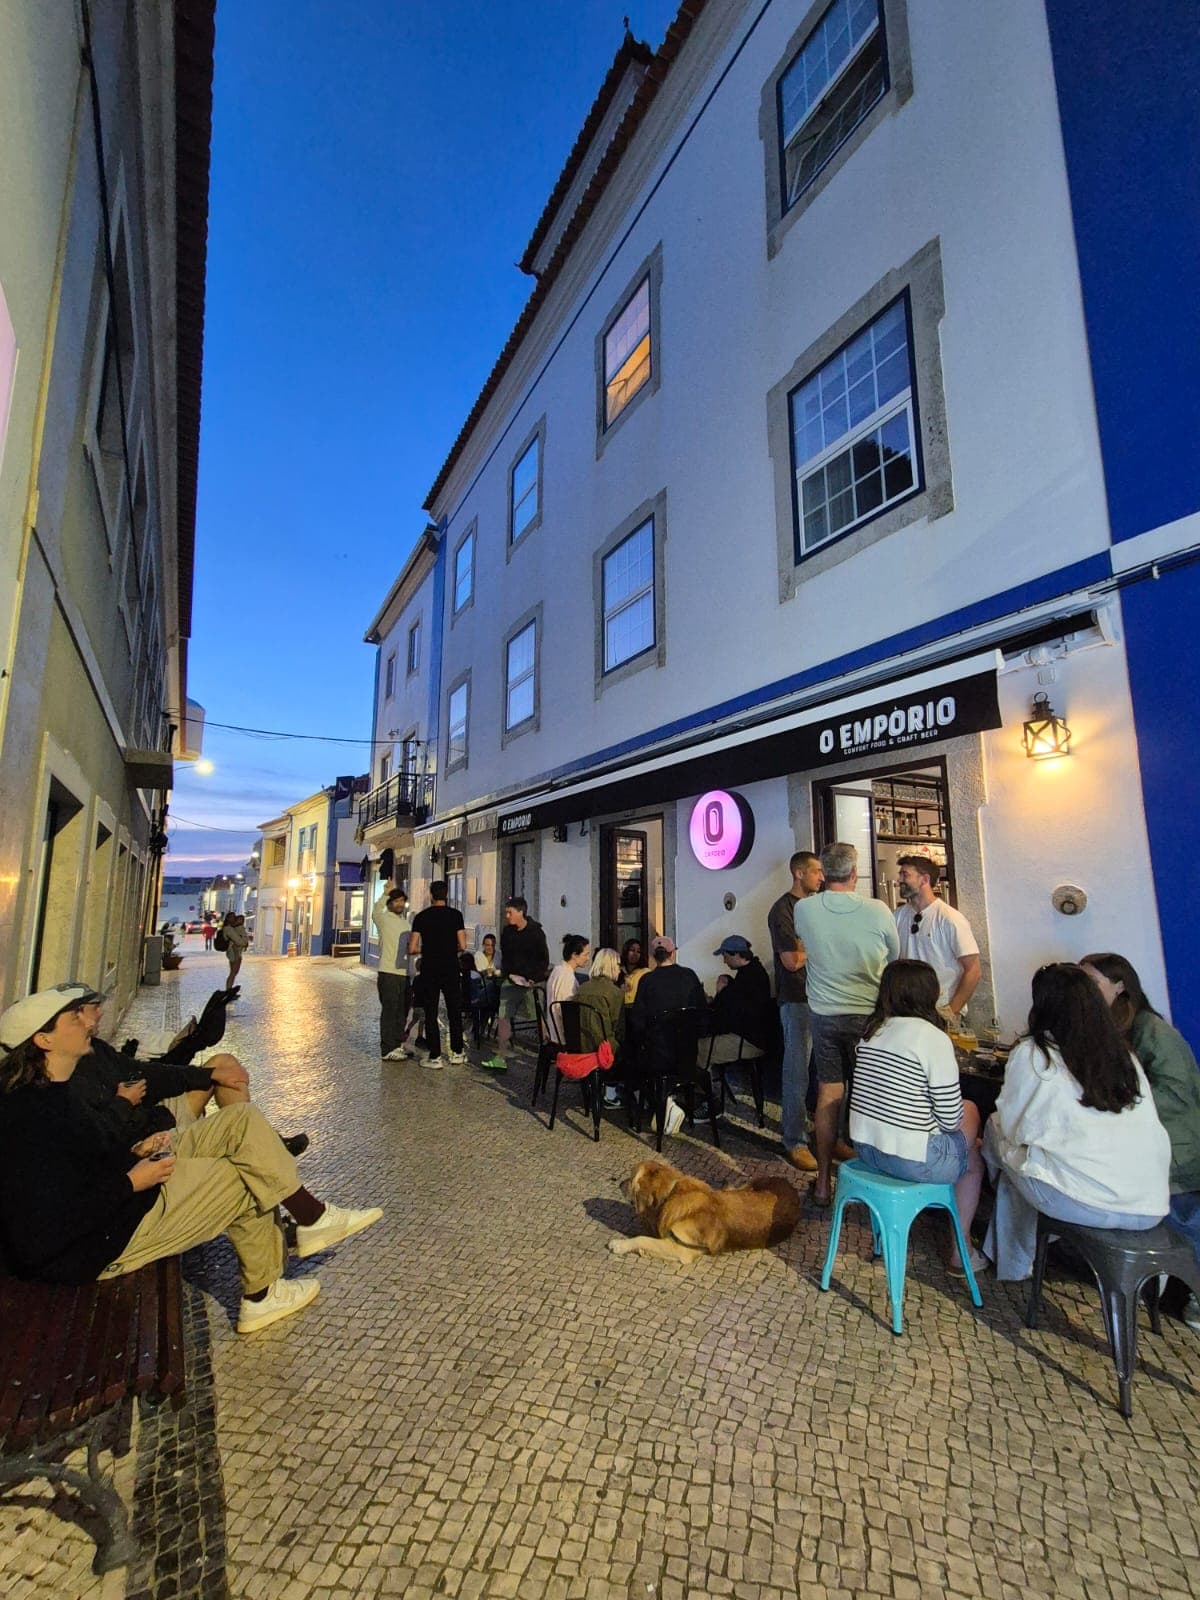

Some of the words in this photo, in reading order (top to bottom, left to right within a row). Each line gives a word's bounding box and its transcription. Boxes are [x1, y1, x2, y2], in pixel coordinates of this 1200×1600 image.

[819, 729, 834, 753] O
[839, 696, 956, 749] EMPÓRIO
[870, 740, 887, 749] FOOD
[896, 733, 918, 744] CRAFT
[920, 729, 938, 739] BEER
[703, 801, 724, 846] O
